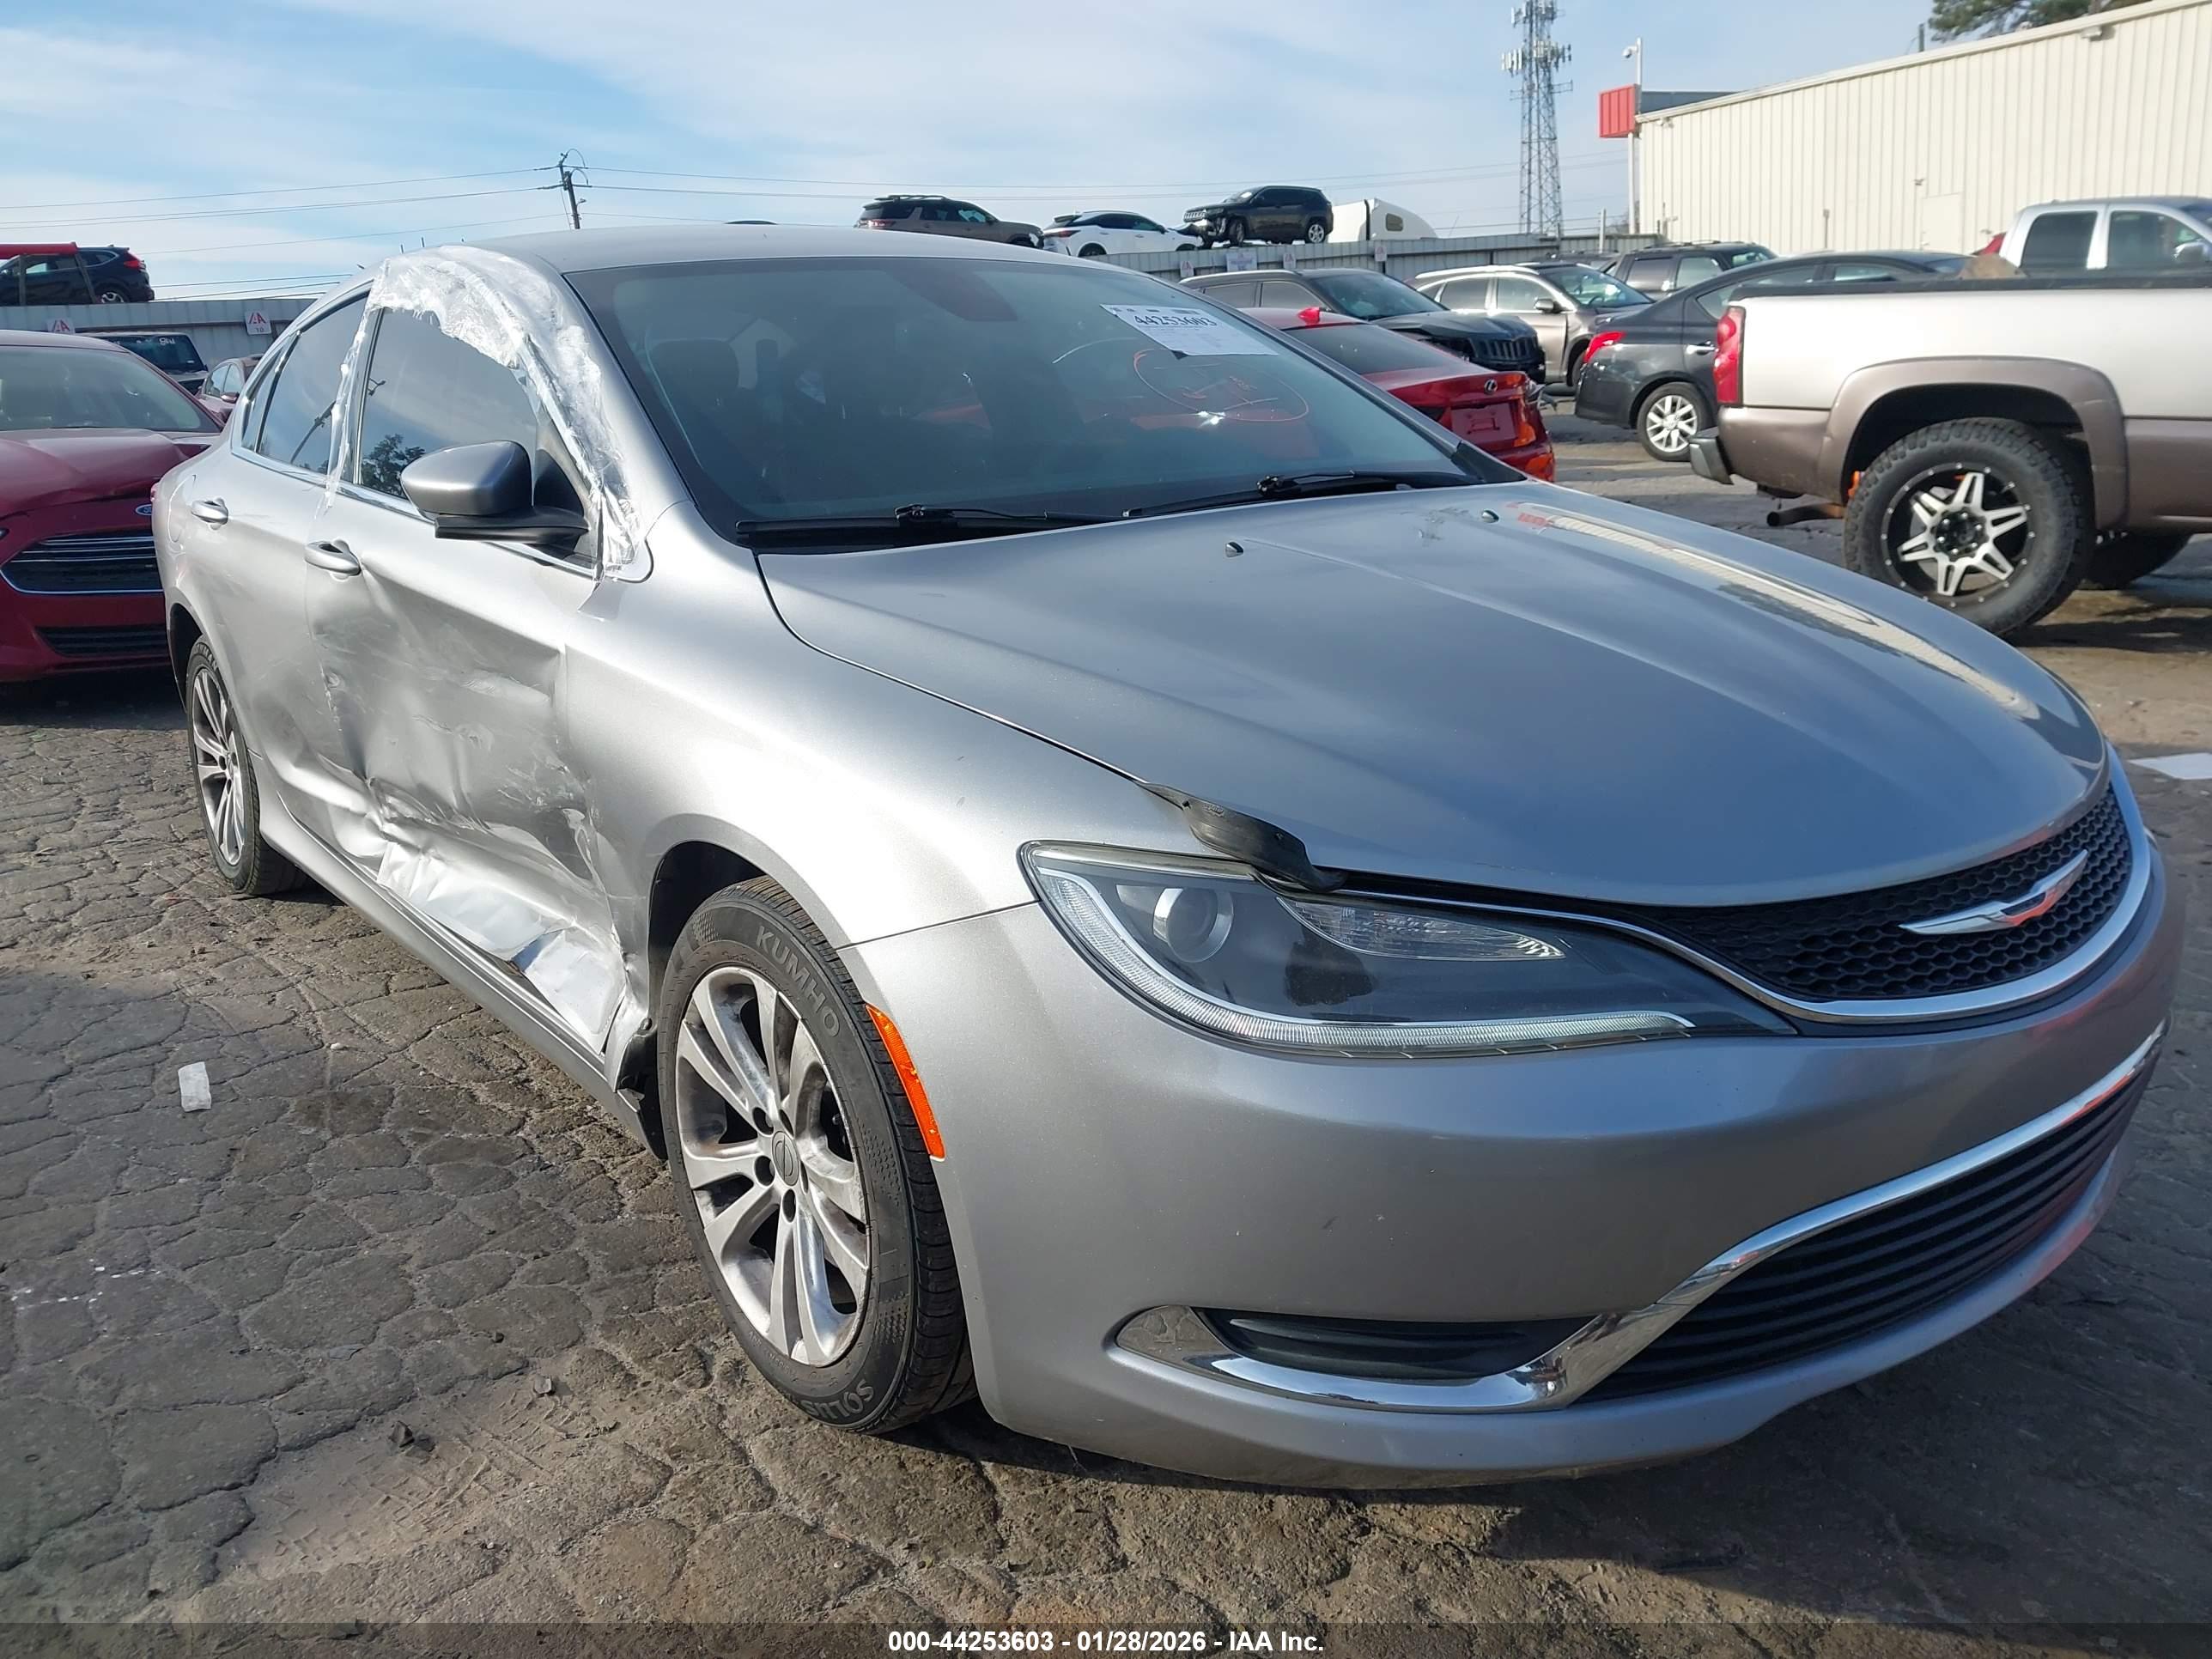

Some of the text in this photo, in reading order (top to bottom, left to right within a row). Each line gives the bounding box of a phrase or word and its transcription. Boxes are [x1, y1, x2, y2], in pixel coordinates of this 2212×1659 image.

[1133, 315, 1218, 327] 44253603
[757, 926, 840, 1037] KUMHO
[799, 1379, 875, 1421] SOLUS
